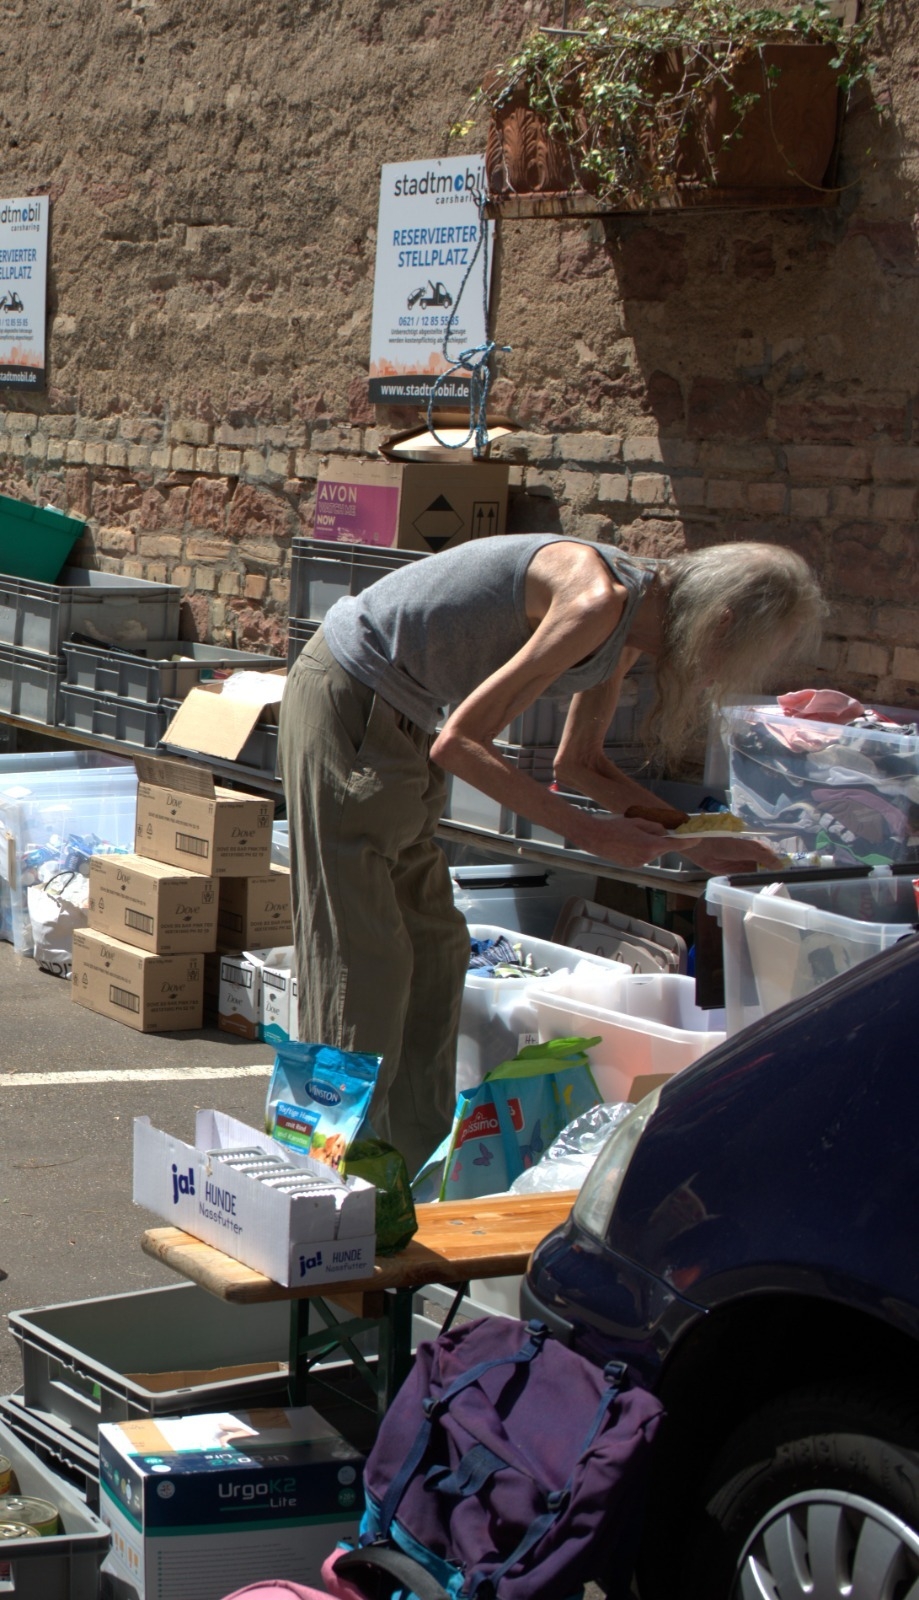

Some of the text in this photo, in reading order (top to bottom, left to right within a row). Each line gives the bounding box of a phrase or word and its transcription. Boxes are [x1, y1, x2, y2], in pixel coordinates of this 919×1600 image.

[393, 166, 486, 196] stadtmobil
[435, 193, 473, 205] carshari
[0, 203, 41, 223] dtmobil
[393, 225, 477, 246] RESERVIERTER
[398, 249, 468, 267] STELLPLATZ
[399, 316, 414, 326] 0621
[422, 316, 428, 326] 12
[430, 316, 439, 326] 85
[319, 483, 358, 503] AVON
[316, 515, 336, 526] NOW
[166, 793, 183, 808] Dove
[231, 826, 256, 838] Dove
[116, 869, 131, 884] Dove
[176, 904, 201, 915] Dove
[264, 900, 288, 912] Dove
[99, 945, 115, 960] Dove
[161, 982, 185, 993] Dove
[226, 992, 243, 1006] Dove
[266, 1001, 280, 1016] Dove
[308, 1083, 339, 1102] WINSTON
[285, 1121, 295, 1129] mit
[171, 1164, 195, 1204] ja!
[205, 1180, 237, 1216] HUNDE
[199, 1201, 243, 1236] Nassfutter
[332, 1248, 362, 1263] HUNDE
[299, 1251, 323, 1277] ja!
[326, 1261, 368, 1273] Nassfutter
[218, 1477, 297, 1500] UrgoK2
[270, 1496, 297, 1508] Lite
